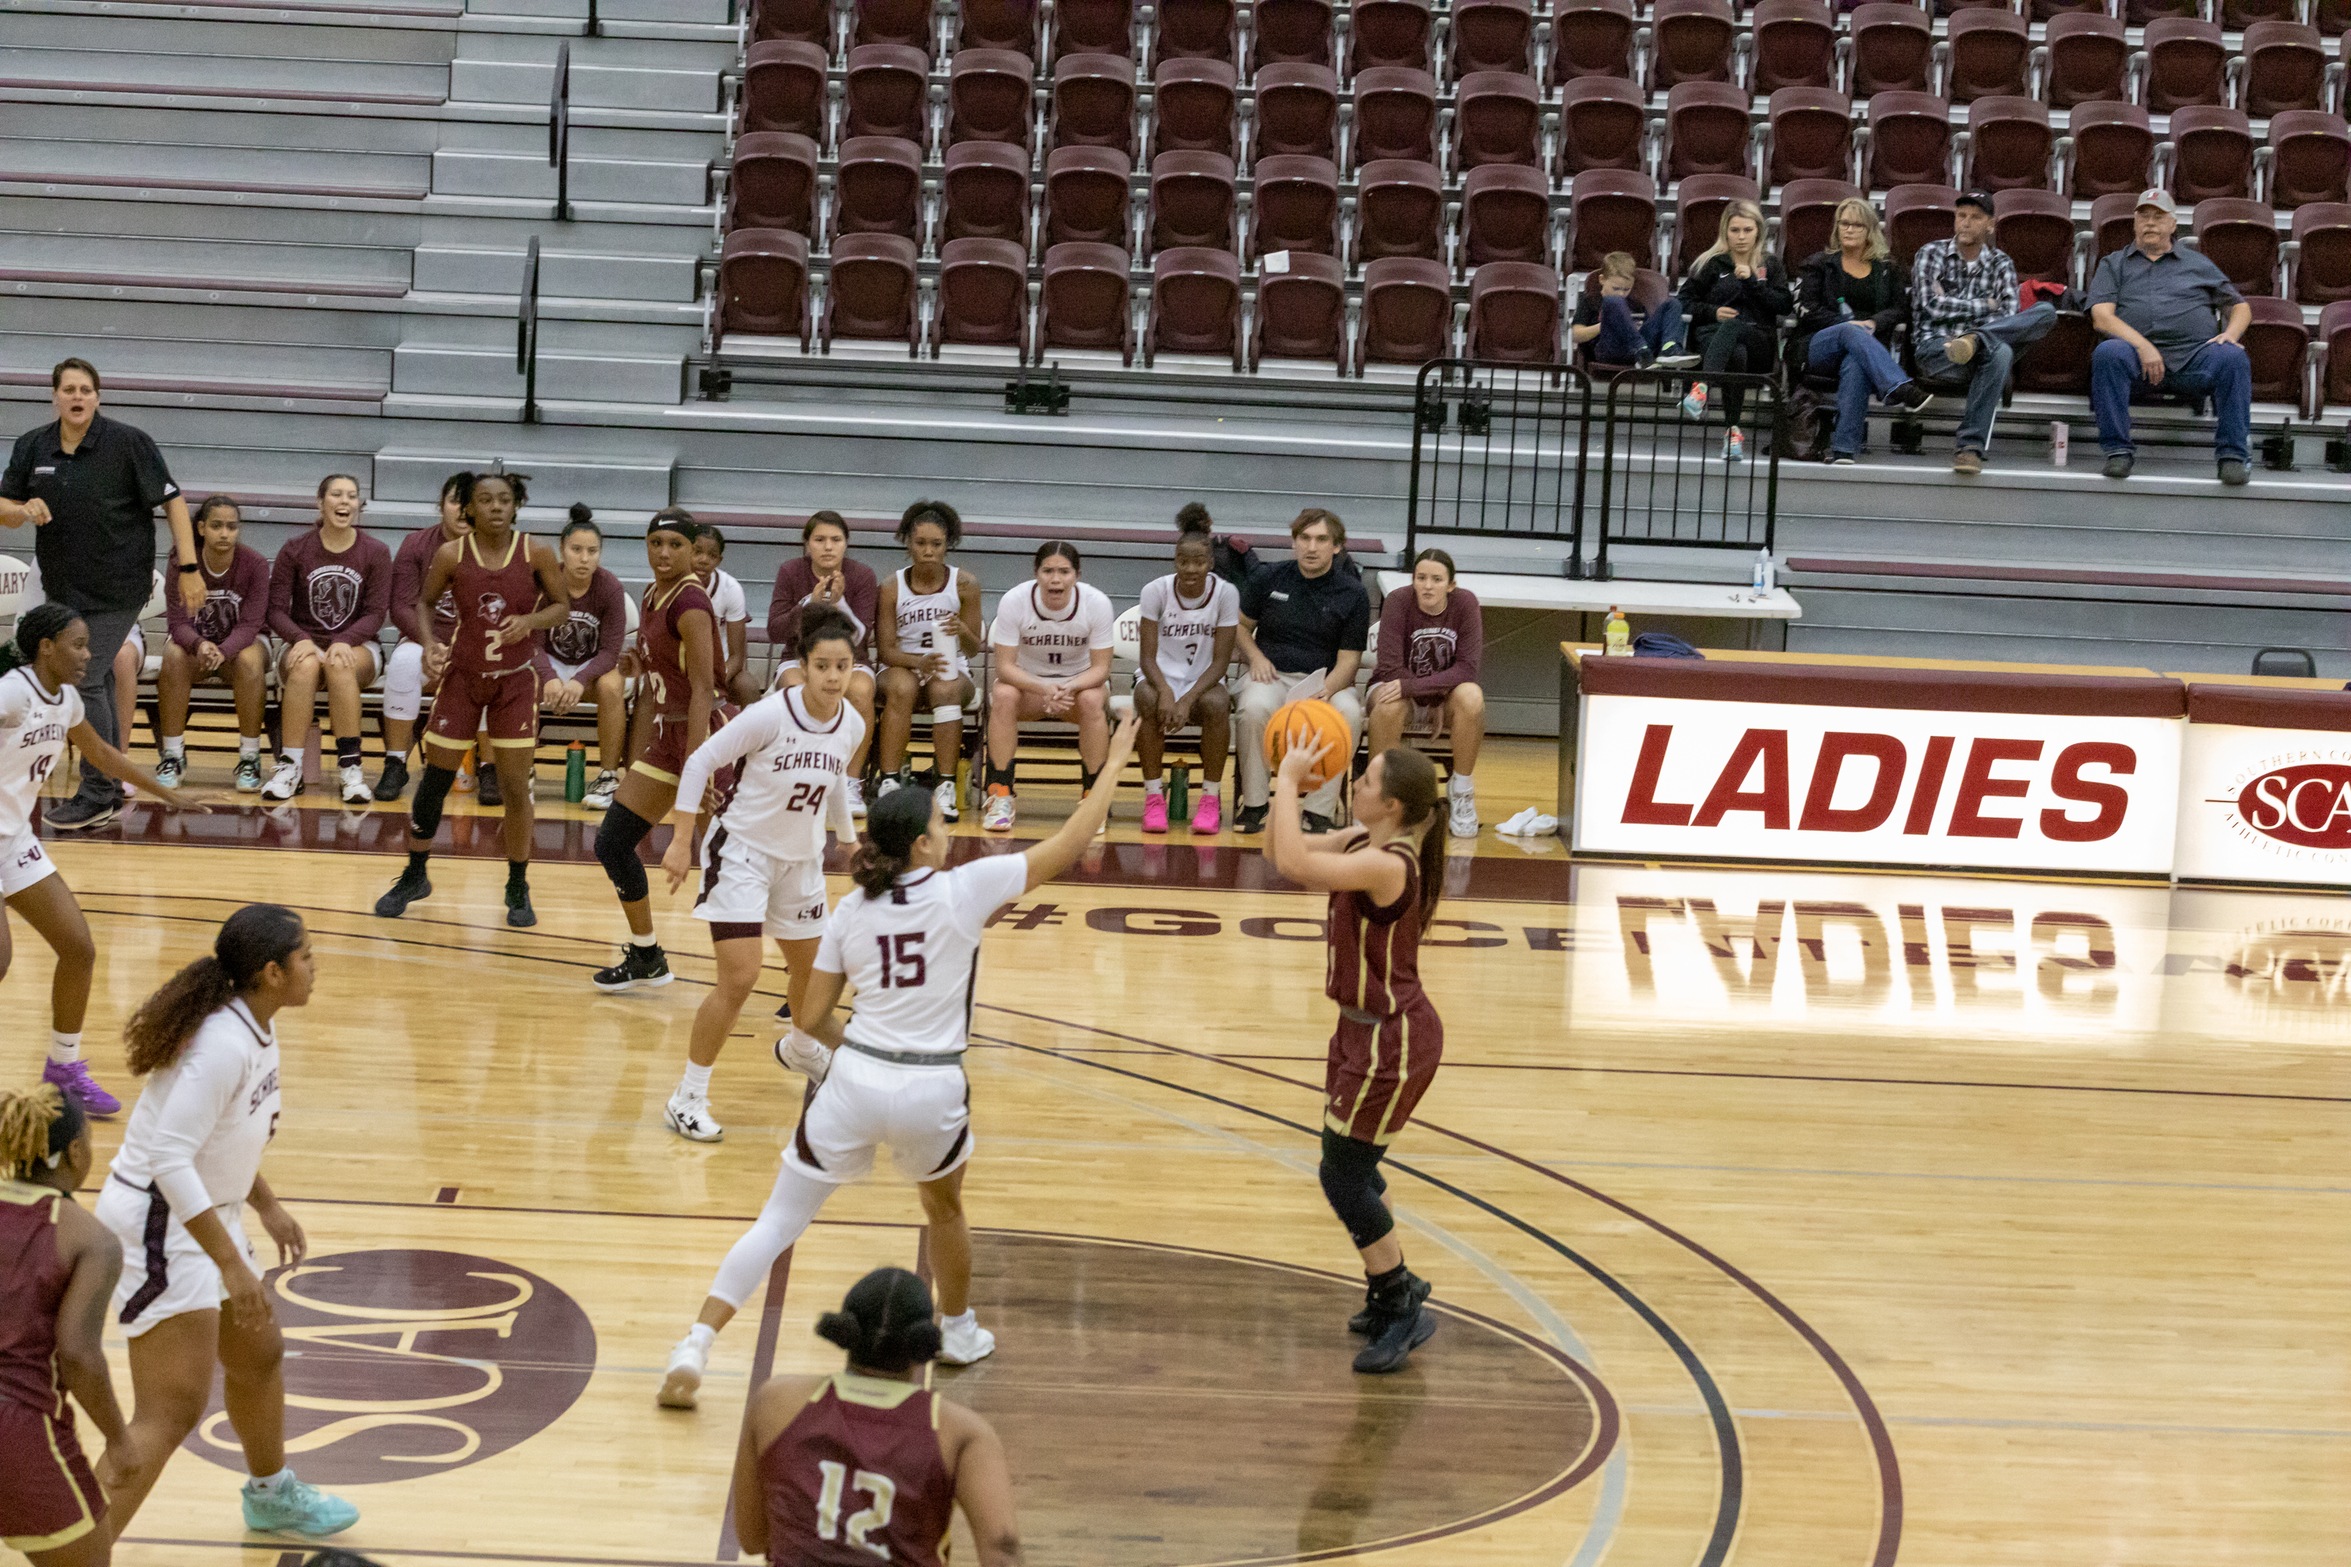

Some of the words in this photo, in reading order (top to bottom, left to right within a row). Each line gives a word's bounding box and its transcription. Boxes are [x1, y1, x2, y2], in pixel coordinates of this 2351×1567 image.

[0, 572, 29, 594] ARY
[485, 630, 504, 662] 2
[1022, 631, 1088, 647] SCHREINER
[1048, 653, 1062, 665] 11
[772, 752, 843, 775] SCHREINE
[2227, 751, 2321, 795] SOUTHERN
[786, 782, 827, 815] 24
[1621, 724, 2137, 842] LADIES
[2224, 811, 2304, 860] ATHLETIC
[876, 931, 926, 988] 15
[199, 1265, 533, 1463] SCAC
[815, 1459, 897, 1562] 12
